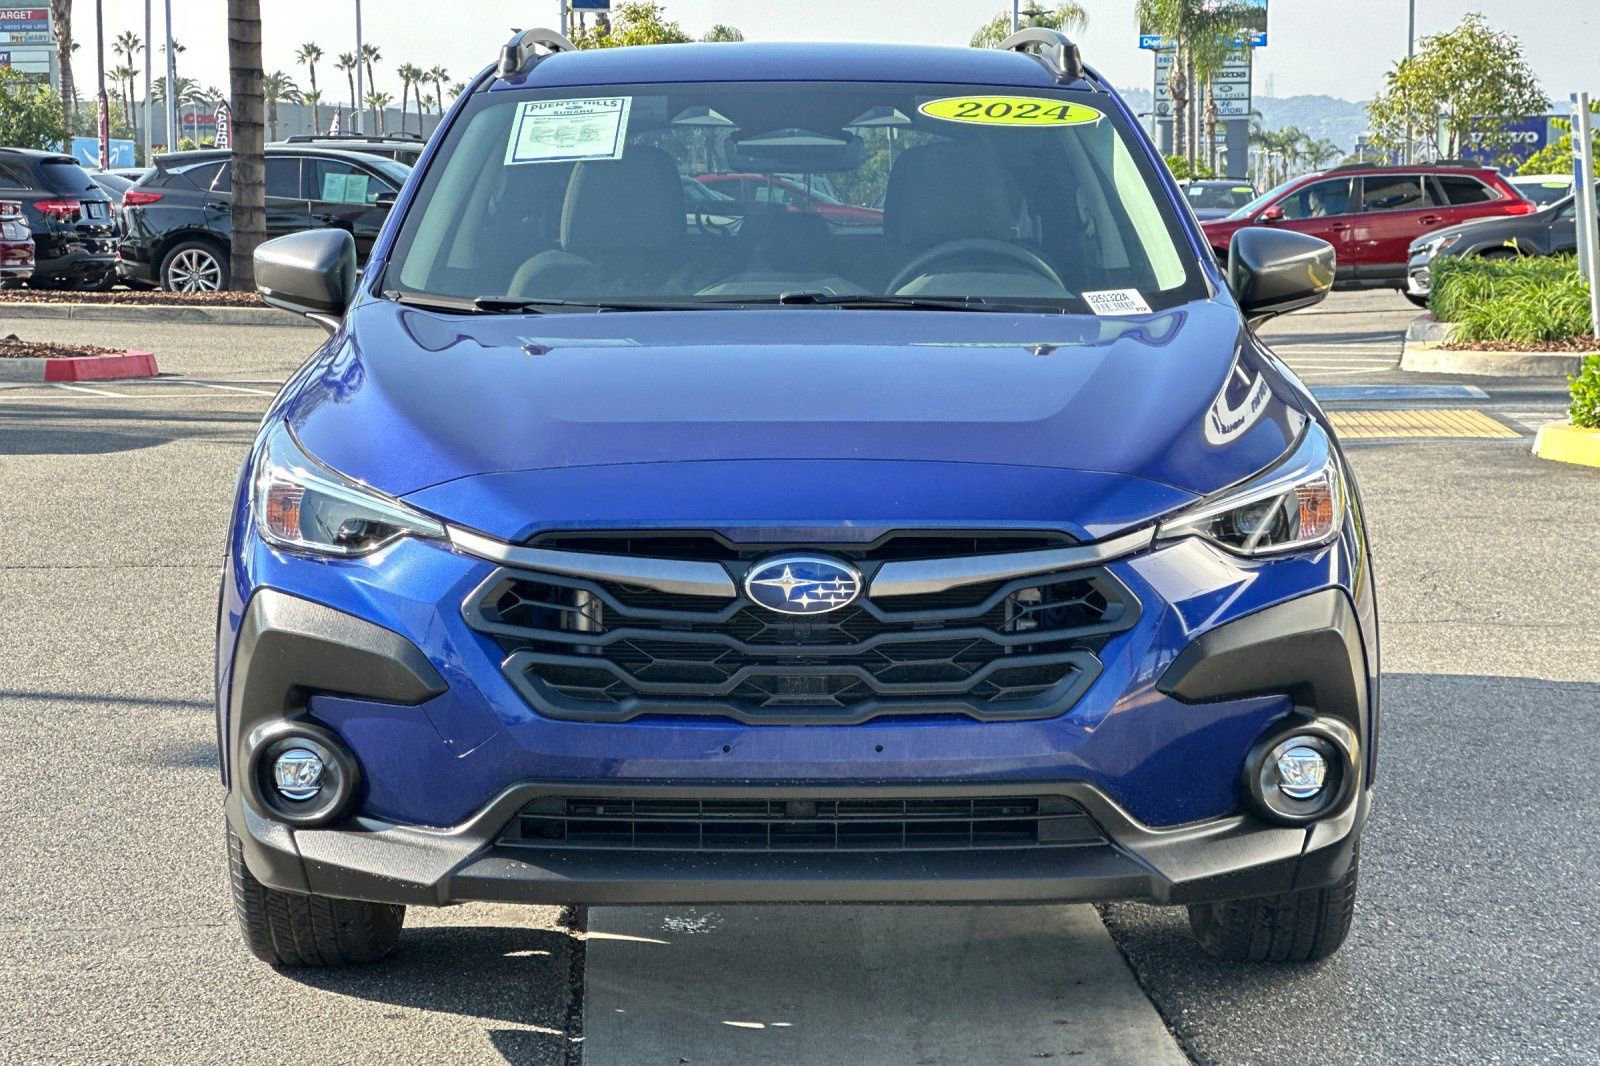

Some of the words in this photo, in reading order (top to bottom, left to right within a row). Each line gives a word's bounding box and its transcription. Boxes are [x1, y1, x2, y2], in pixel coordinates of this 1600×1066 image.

[0, 11, 32, 19] ARGET
[530, 101, 579, 112] PUENTE
[953, 102, 1073, 120] 2024
[1470, 131, 1539, 143] VVO
